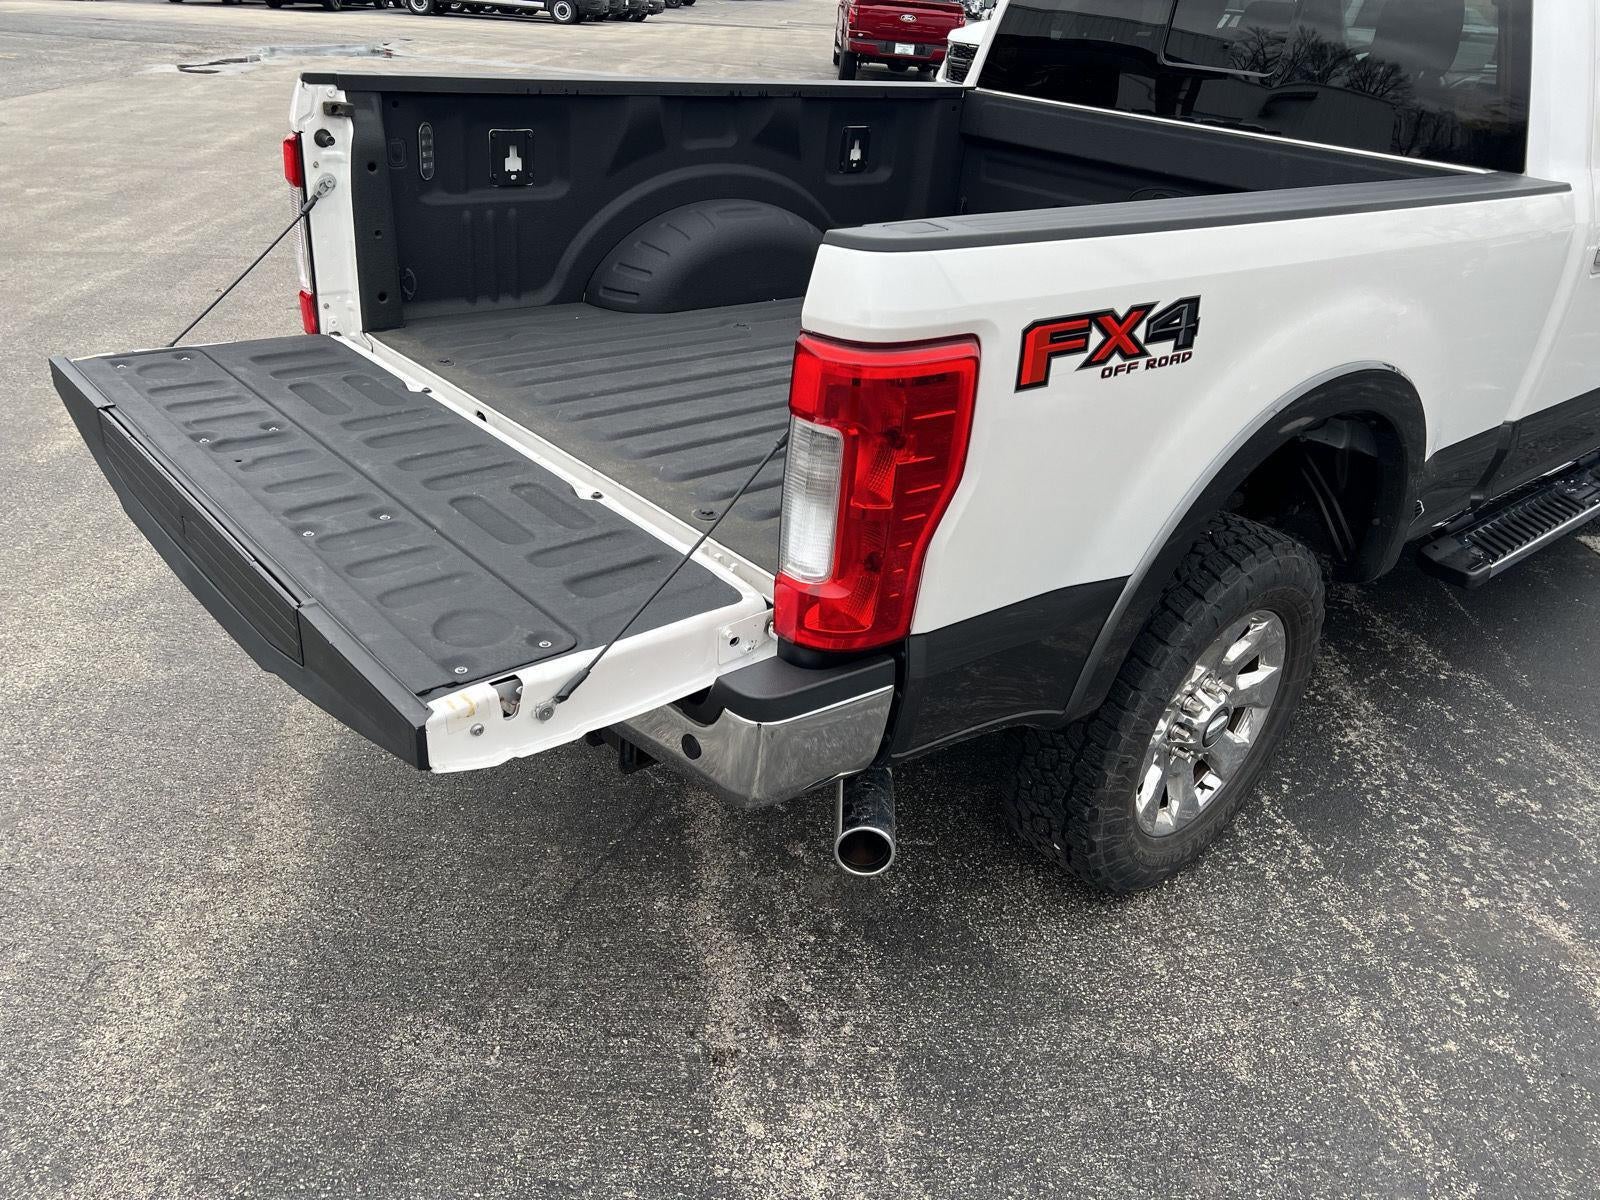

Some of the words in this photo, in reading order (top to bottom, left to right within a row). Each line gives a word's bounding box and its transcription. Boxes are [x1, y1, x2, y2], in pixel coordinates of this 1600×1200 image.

[1014, 294, 1202, 394] FX4
[1100, 361, 1139, 380] OFF
[1144, 350, 1193, 371] ROAD
